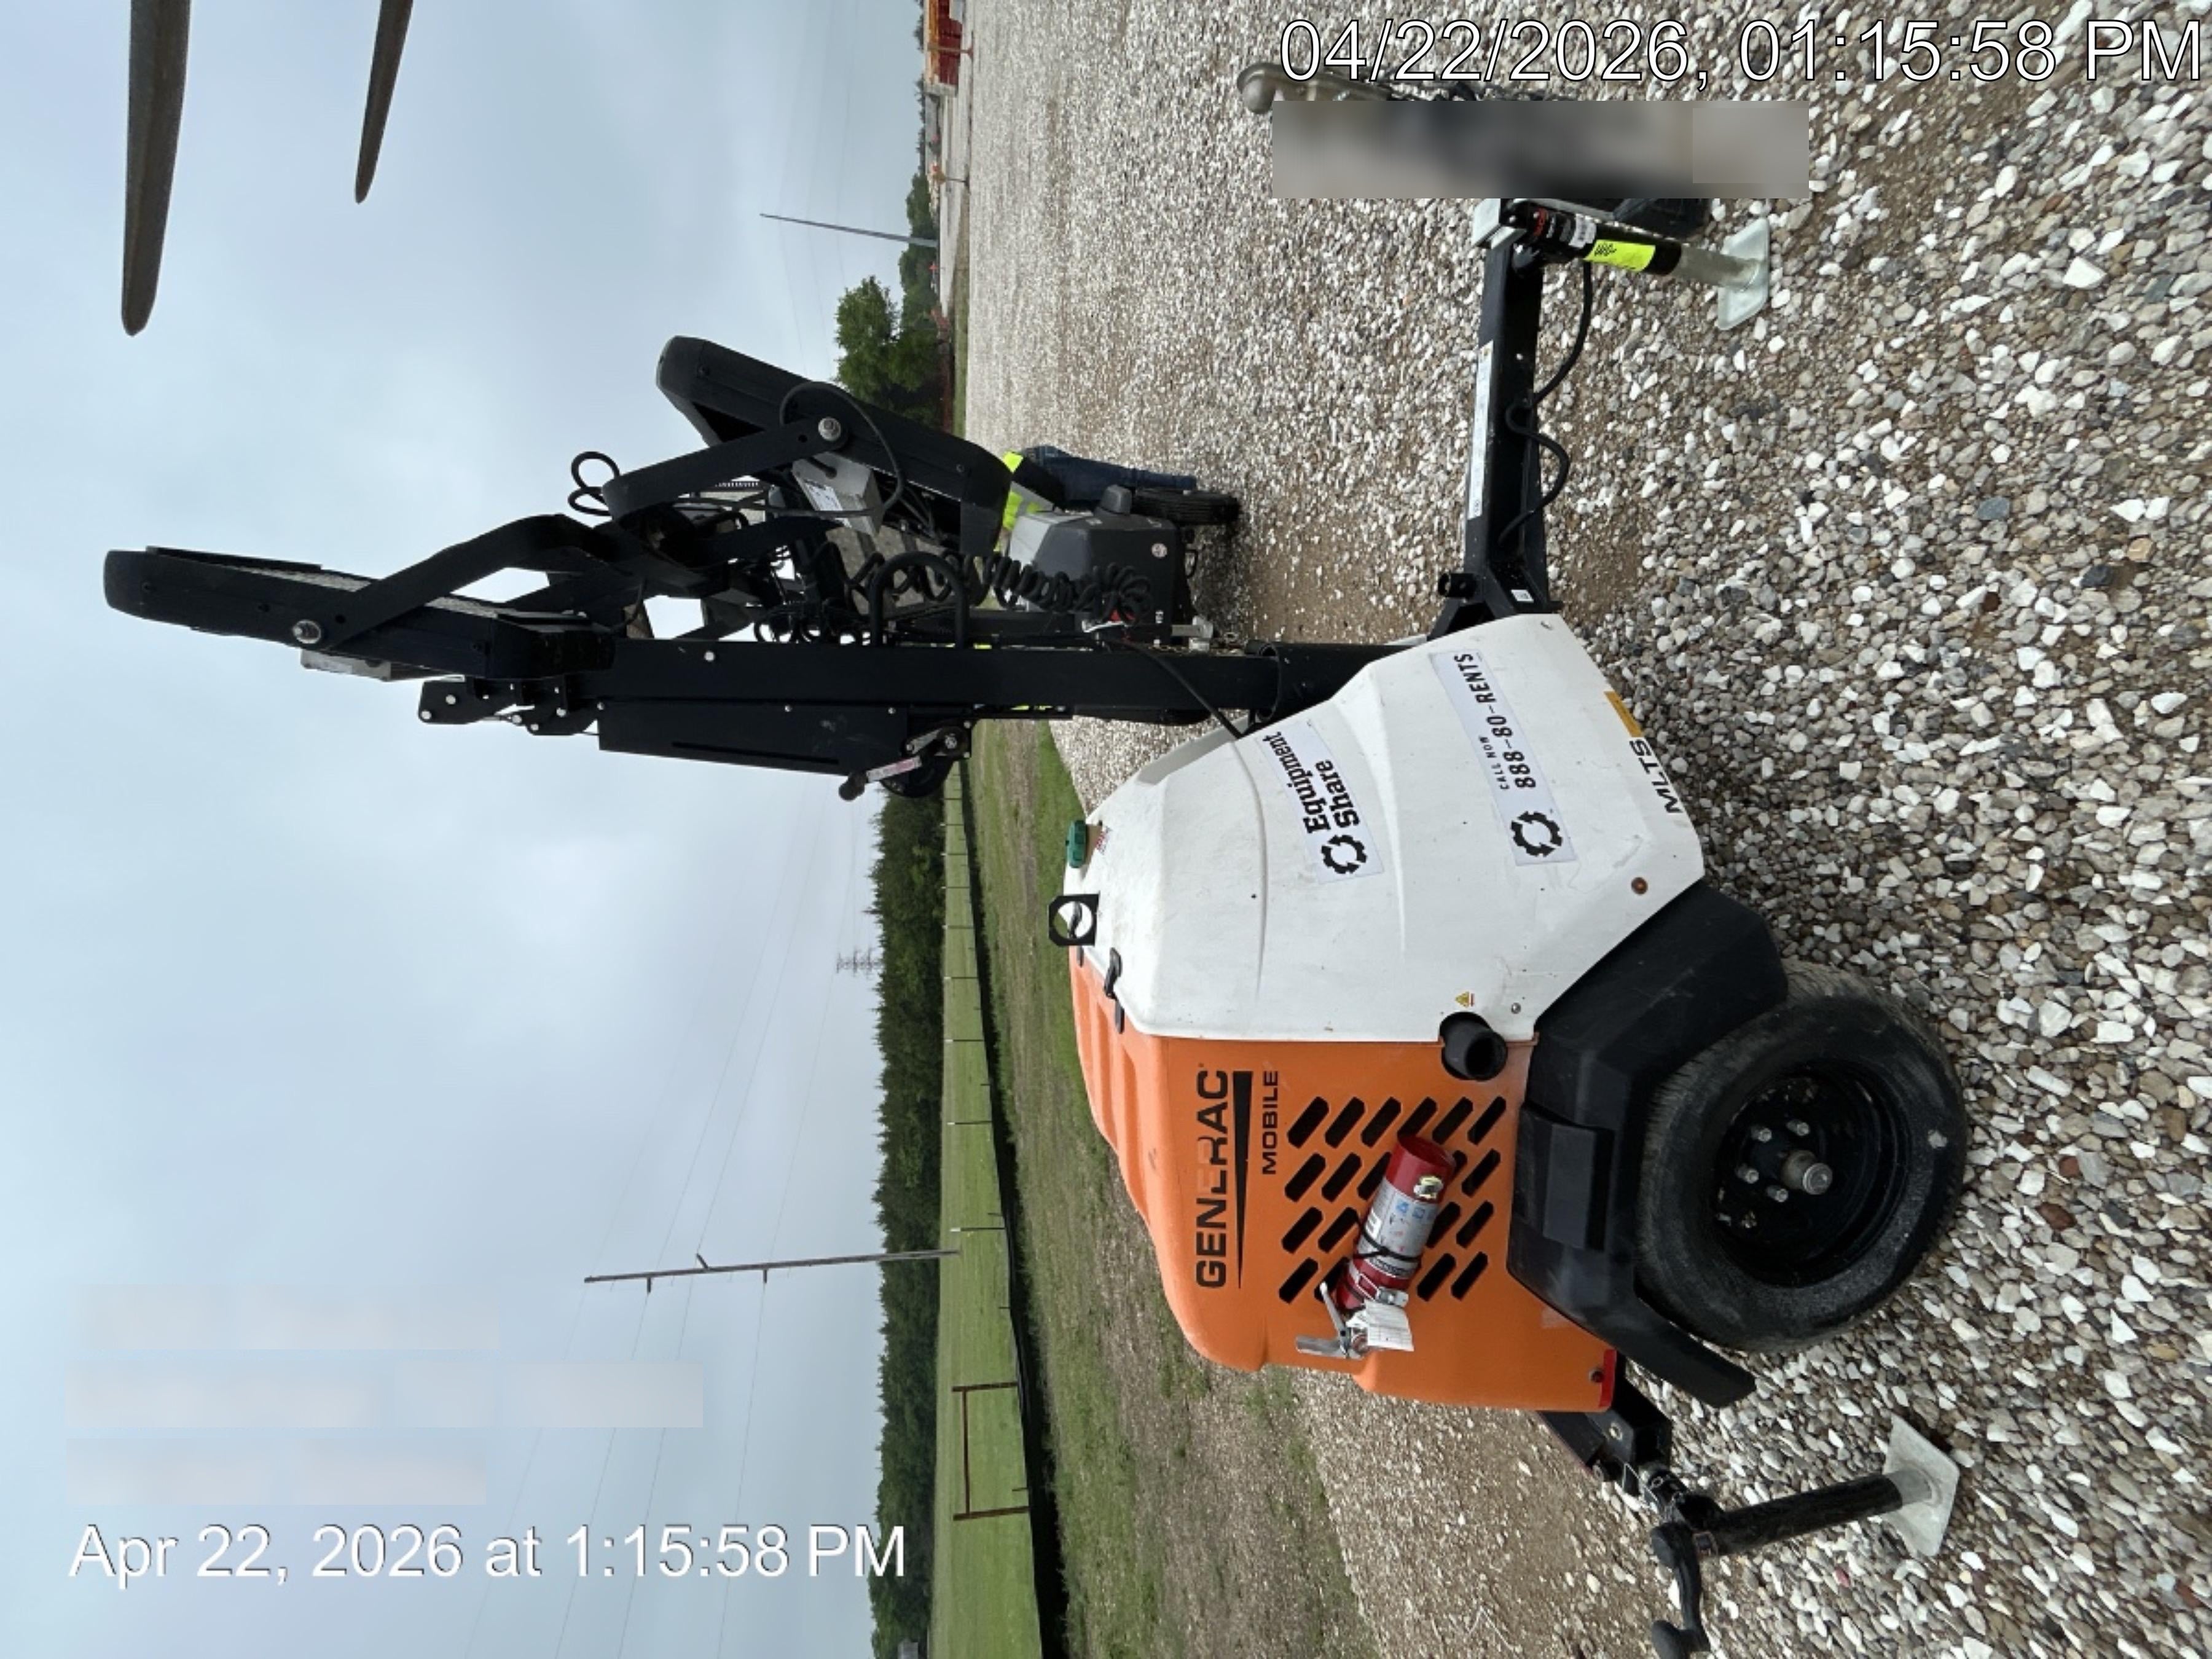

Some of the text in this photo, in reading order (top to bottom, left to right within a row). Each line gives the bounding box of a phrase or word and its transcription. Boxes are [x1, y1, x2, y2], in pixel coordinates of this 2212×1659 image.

[1454, 653, 1536, 789] 888-80-RENTS
[1478, 736, 1510, 790] CALL NOW
[1262, 731, 1332, 833] Equipment
[1315, 759, 1361, 828] Share
[1629, 739, 1684, 814] MLTS
[1262, 1070, 1279, 1175] MOBILE
